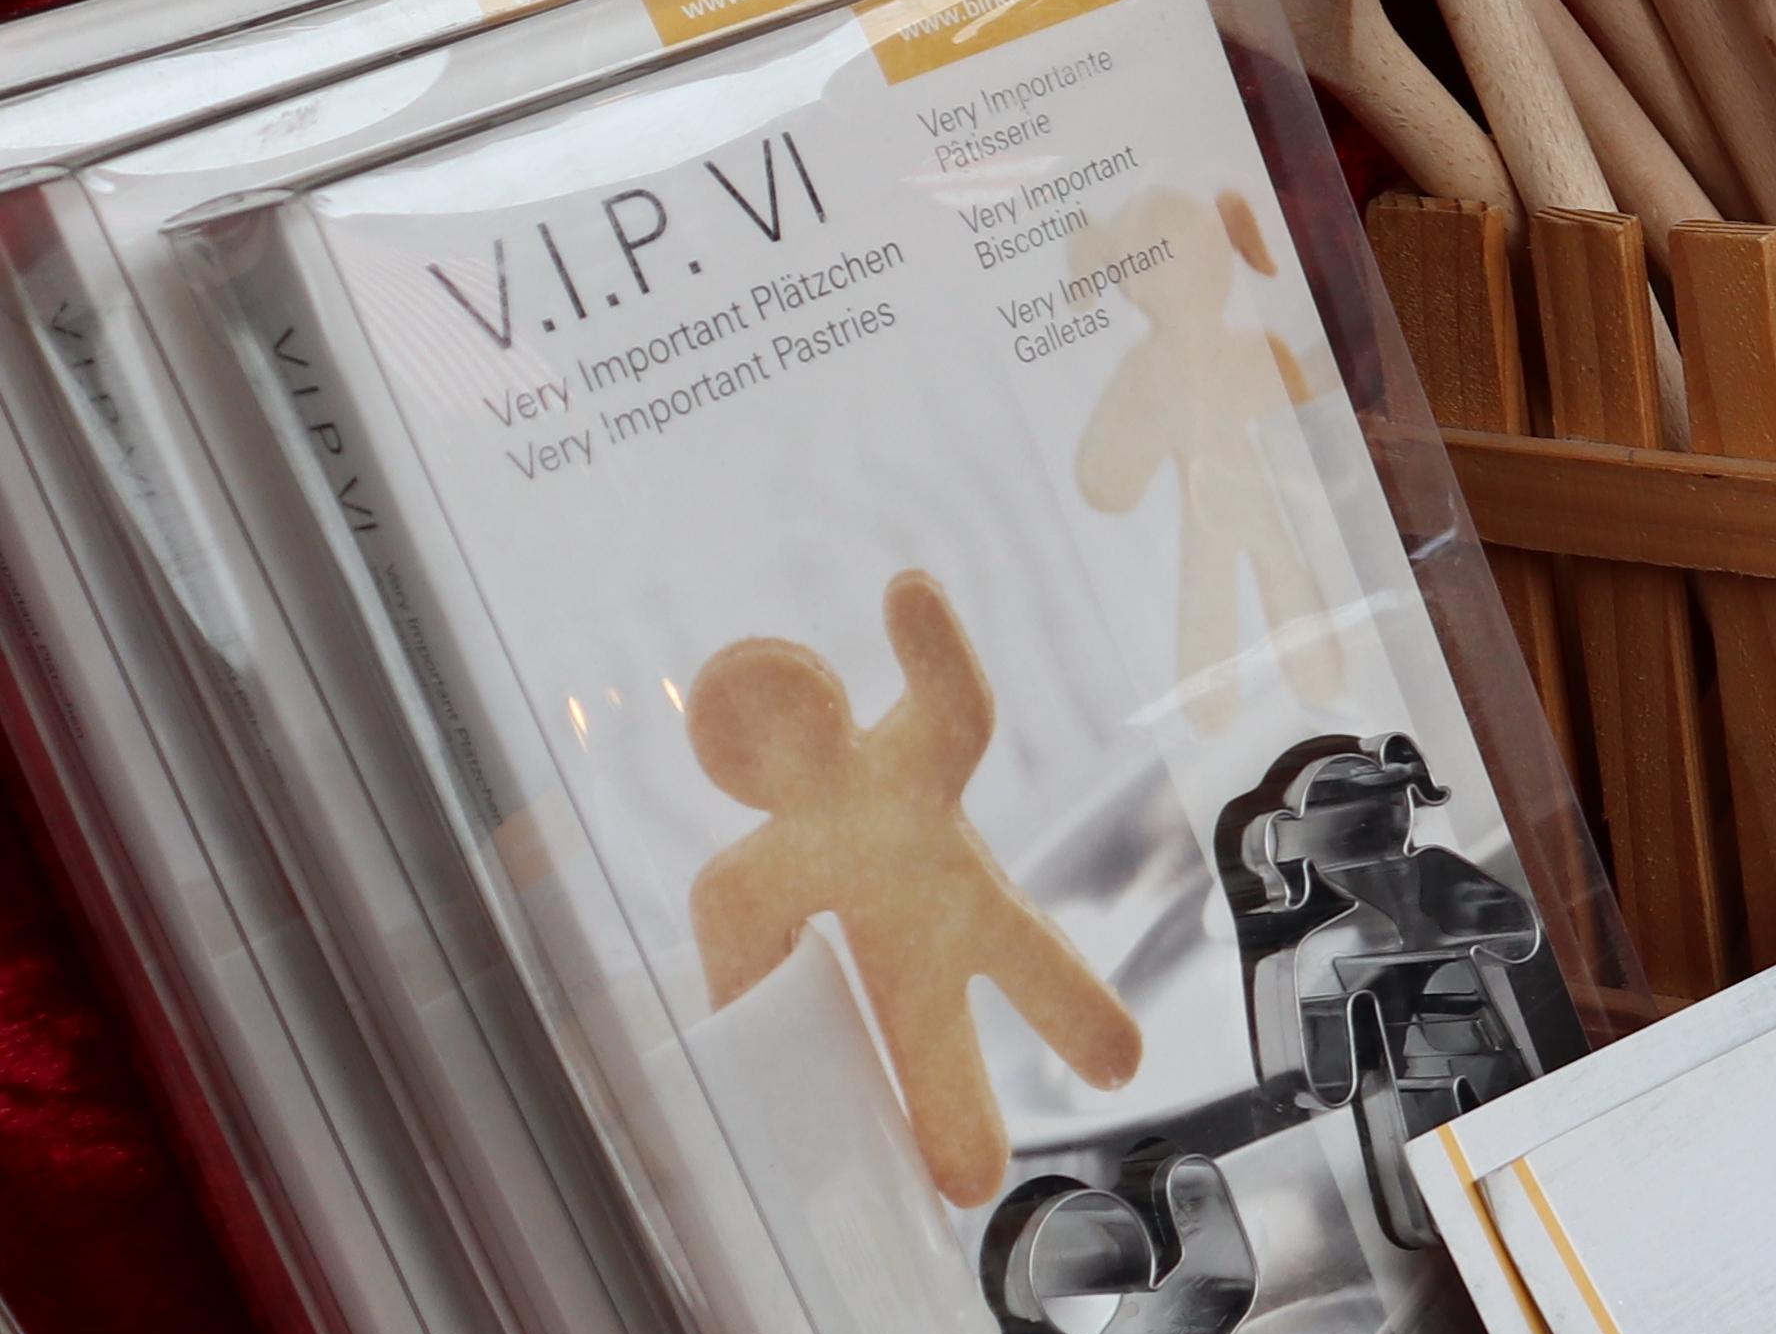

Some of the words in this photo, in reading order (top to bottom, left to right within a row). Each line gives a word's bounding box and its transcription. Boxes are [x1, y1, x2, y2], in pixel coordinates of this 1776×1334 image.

[917, 99, 979, 140] Very
[980, 48, 1115, 114] Importante
[934, 111, 1054, 173] Pâtisserie
[958, 196, 1018, 235] Very
[1020, 145, 1140, 208] Important
[427, 186, 703, 351] V.I.P.
[705, 131, 828, 244] VI
[973, 203, 1090, 270] Biscottini
[997, 291, 1056, 331] Very
[1057, 237, 1175, 305] Important
[484, 367, 574, 430] Very
[580, 301, 748, 396] Important
[748, 237, 907, 334] Plätzchen
[1013, 305, 1112, 364] Galletas
[506, 418, 594, 483] Very
[604, 348, 771, 447] Important
[771, 299, 898, 376] Pastries
